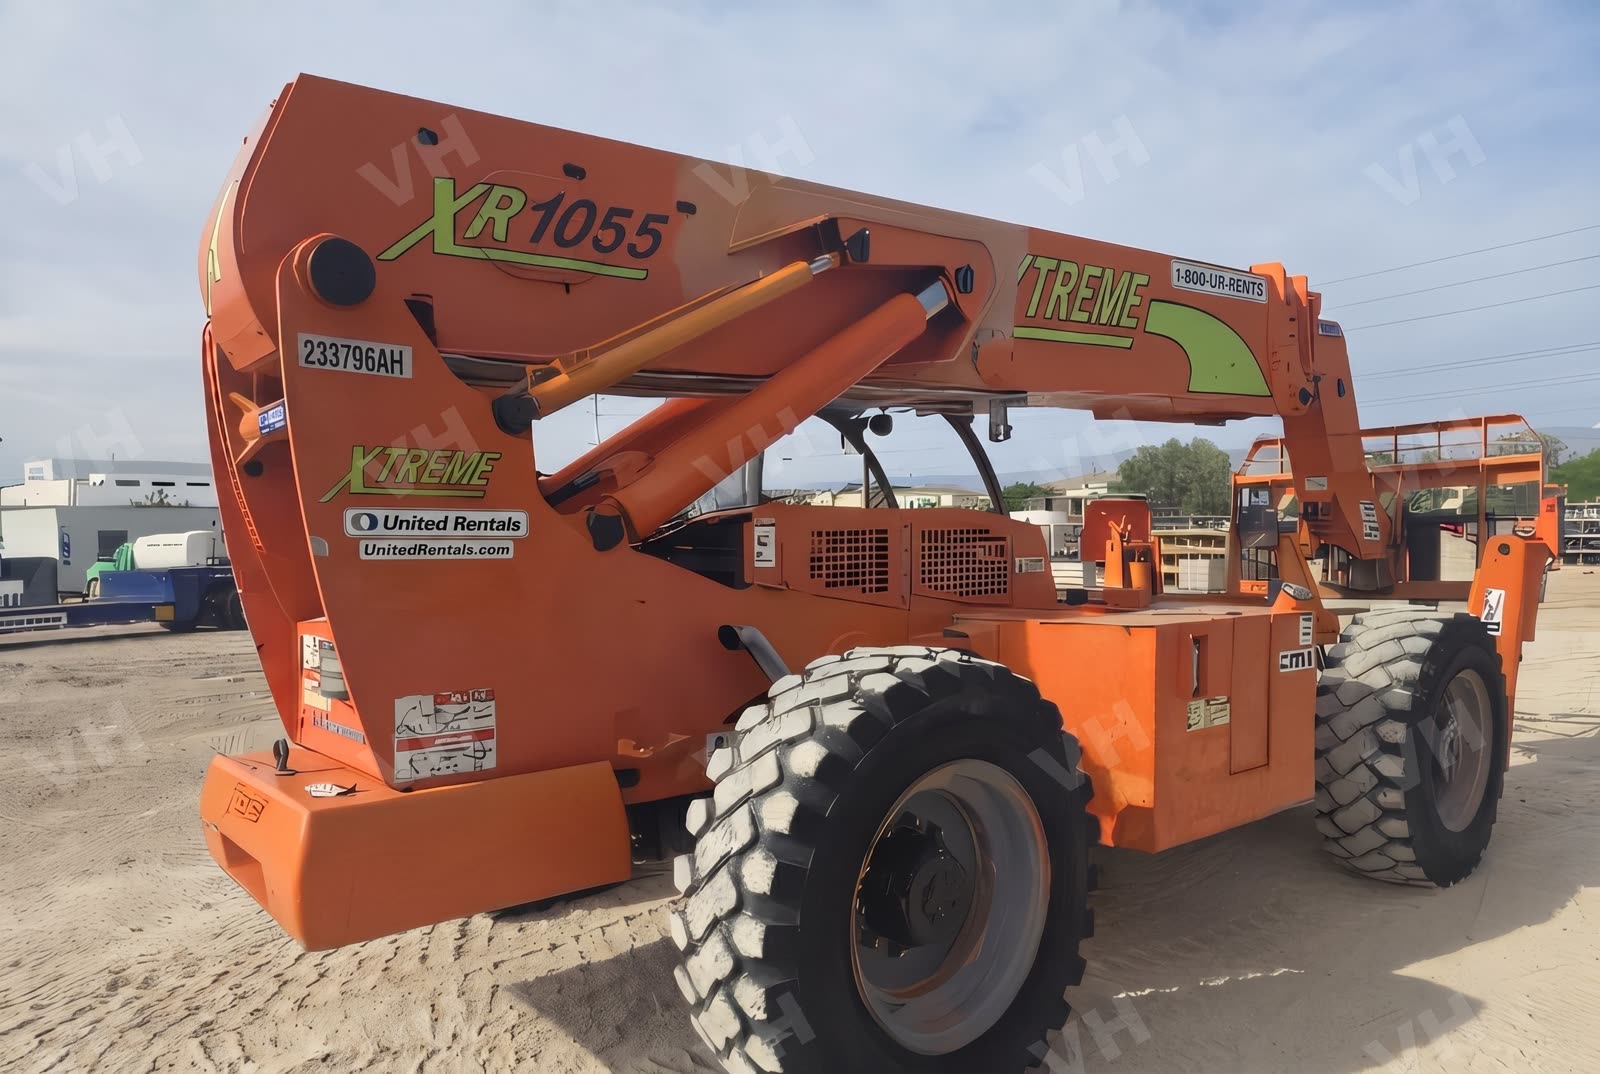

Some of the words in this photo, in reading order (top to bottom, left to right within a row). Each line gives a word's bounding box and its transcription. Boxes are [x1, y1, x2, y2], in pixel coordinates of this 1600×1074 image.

[1175, 267, 1264, 297] 1-800-UR-RENTS
[303, 339, 404, 376] 233796AH
[317, 445, 502, 502] XTREME
[382, 514, 448, 532] United
[453, 515, 521, 533] Rentals
[363, 543, 510, 557] UnitedRentals.com
